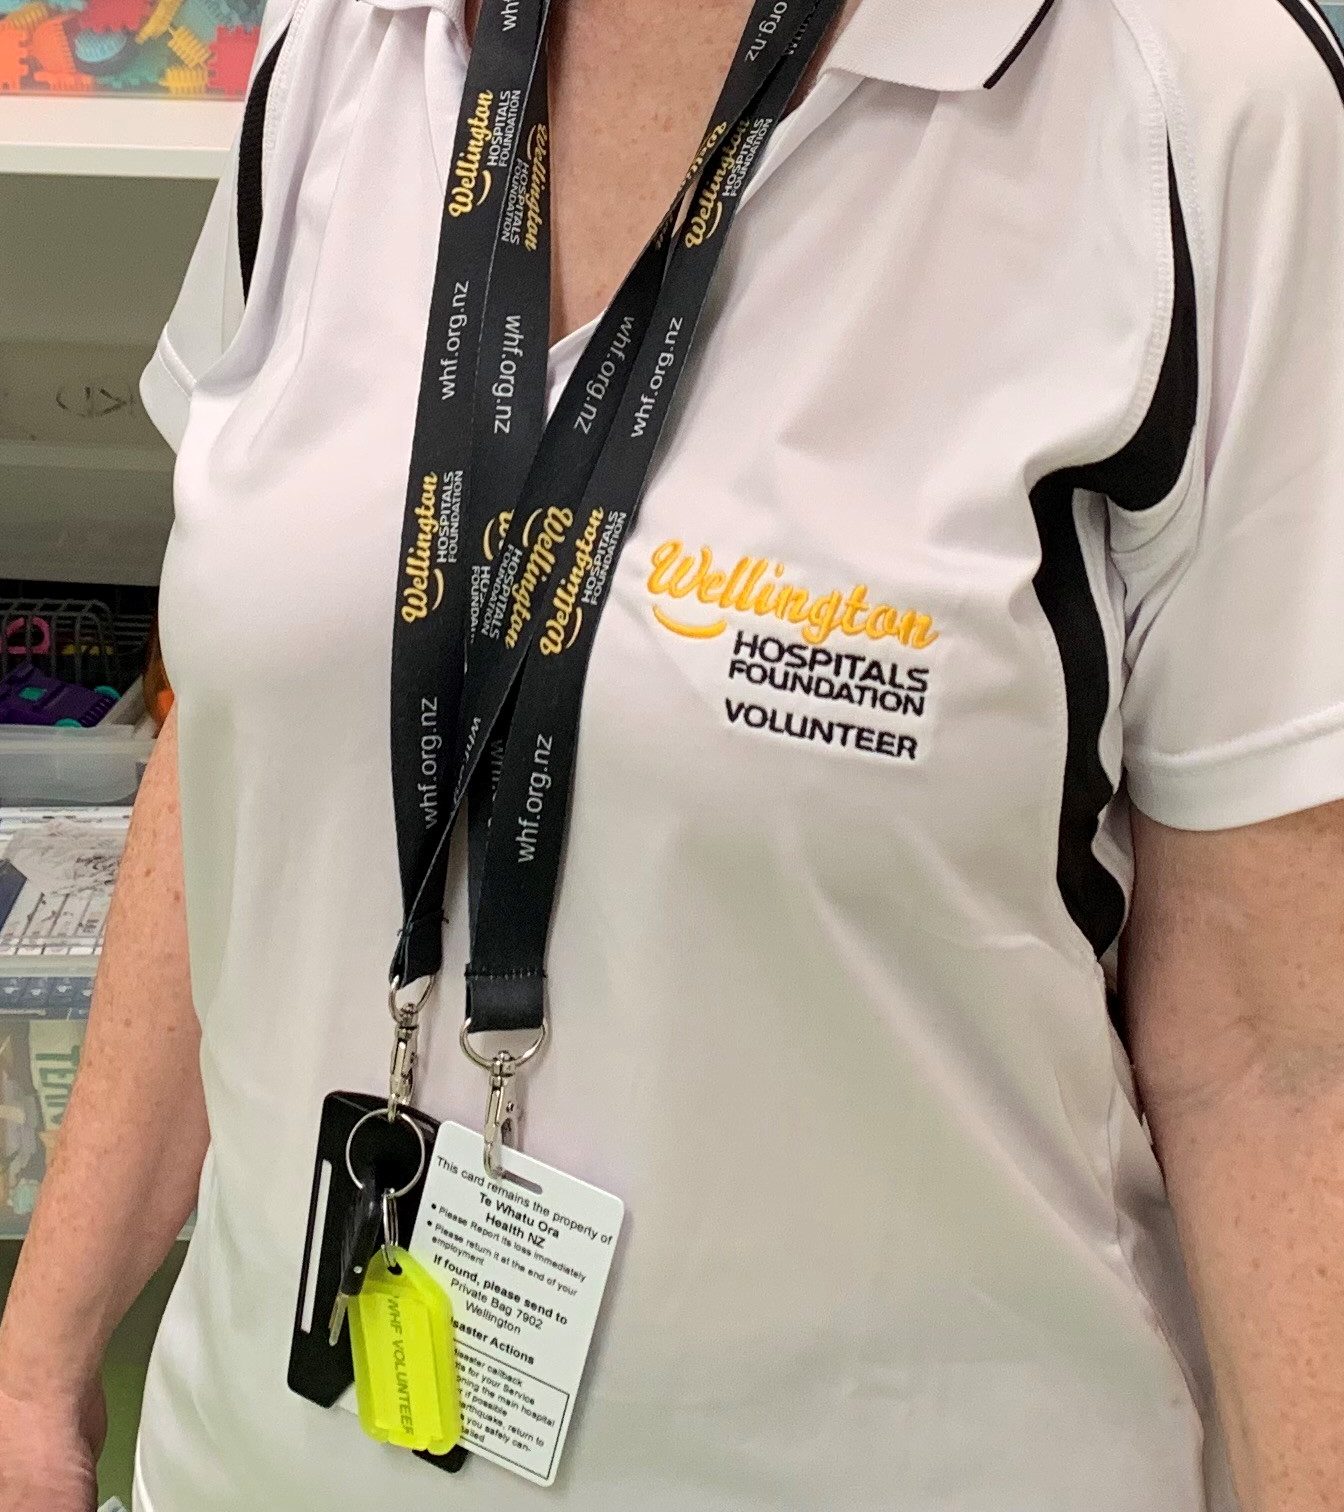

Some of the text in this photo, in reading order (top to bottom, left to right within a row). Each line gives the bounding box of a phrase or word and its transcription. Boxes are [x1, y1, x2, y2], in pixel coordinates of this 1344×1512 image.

[448, 89, 494, 217] Wellington
[487, 90, 511, 166] HOSPITALS
[499, 90, 521, 167] FOUNDATION
[722, 118, 764, 197] HOSPITALS
[730, 118, 773, 197] FOUNDATION
[501, 157, 522, 242] FOUNDATION
[510, 161, 529, 245] HOSPITALS
[524, 123, 548, 252] Wellington
[685, 118, 750, 248] Wellington
[438, 280, 470, 400] whf.org.nz
[492, 315, 524, 434] whf.org.nz
[573, 316, 635, 435] whf.org.nz
[630, 316, 683, 438] whf.org.nz
[401, 472, 439, 623] Wellington
[436, 471, 455, 563] HOSPITALS
[448, 470, 463, 563] FOUNDATION
[581, 510, 619, 604] HOSPITALS
[481, 544, 515, 637] FOUNDATION
[489, 547, 523, 640] HOSPITALS
[505, 505, 574, 649] Wellington
[540, 506, 605, 656] Wellington
[590, 511, 627, 606] FOUNDATION
[646, 538, 939, 650] Wellington
[728, 659, 926, 717] FOUNDATION
[732, 630, 930, 693] HOSPITALS
[418, 696, 443, 830] whf.org.nz
[725, 697, 919, 761] VOLUNTEER
[515, 733, 553, 863] whf.org.nz
[436, 1155, 613, 1246] This card remains the property of
[479, 1192, 560, 1239] Te Whatu Ora
[485, 1213, 547, 1248] Health NZ
[431, 1236, 485, 1266] employment
[434, 1223, 464, 1243] Please
[466, 1238, 492, 1257] return
[511, 1260, 526, 1273] the
[527, 1268, 545, 1281] end
[557, 1282, 578, 1297] your
[439, 1206, 587, 1283] Please Report its loss immediately
[387, 1297, 402, 1335] WHF
[433, 1254, 568, 1325] If found, please send to
[450, 1278, 543, 1331] Private Bag 7902
[465, 1299, 521, 1335] Wellington
[451, 1316, 535, 1365] isaster Actions
[459, 1401, 545, 1447] arthquake, return to
[468, 1367, 480, 1378] for
[481, 1374, 501, 1389] your
[503, 1383, 535, 1406] Service
[472, 1395, 508, 1417] possible
[481, 1386, 495, 1399] the
[497, 1394, 519, 1410] main
[521, 1405, 555, 1428] hospital
[466, 1417, 483, 1430] you
[484, 1424, 511, 1444] safely
